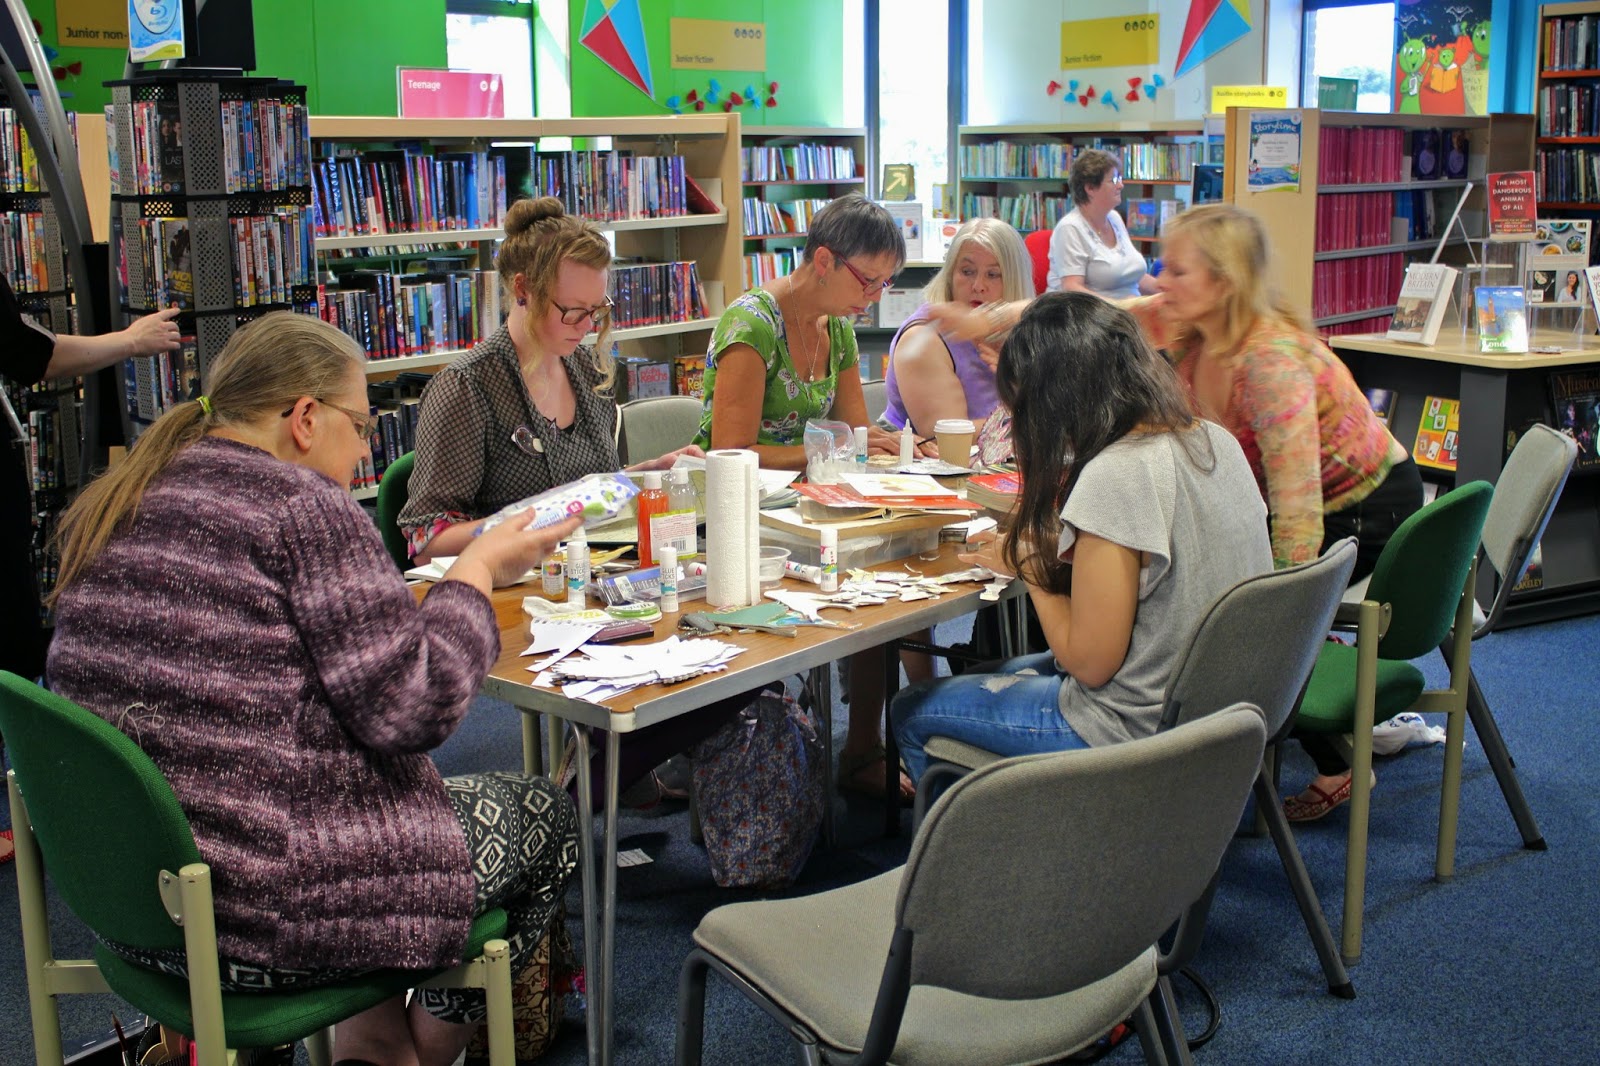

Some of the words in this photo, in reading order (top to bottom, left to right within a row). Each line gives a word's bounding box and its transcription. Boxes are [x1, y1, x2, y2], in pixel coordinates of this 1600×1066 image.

[65, 27, 99, 39] Junior
[103, 30, 127, 40] non-
[407, 80, 441, 91] Teenage
[1254, 121, 1297, 133] Storytime
[165, 156, 181, 165] LAS
[1408, 272, 1440, 280] MODERN
[1407, 281, 1435, 289] BRITAIN
